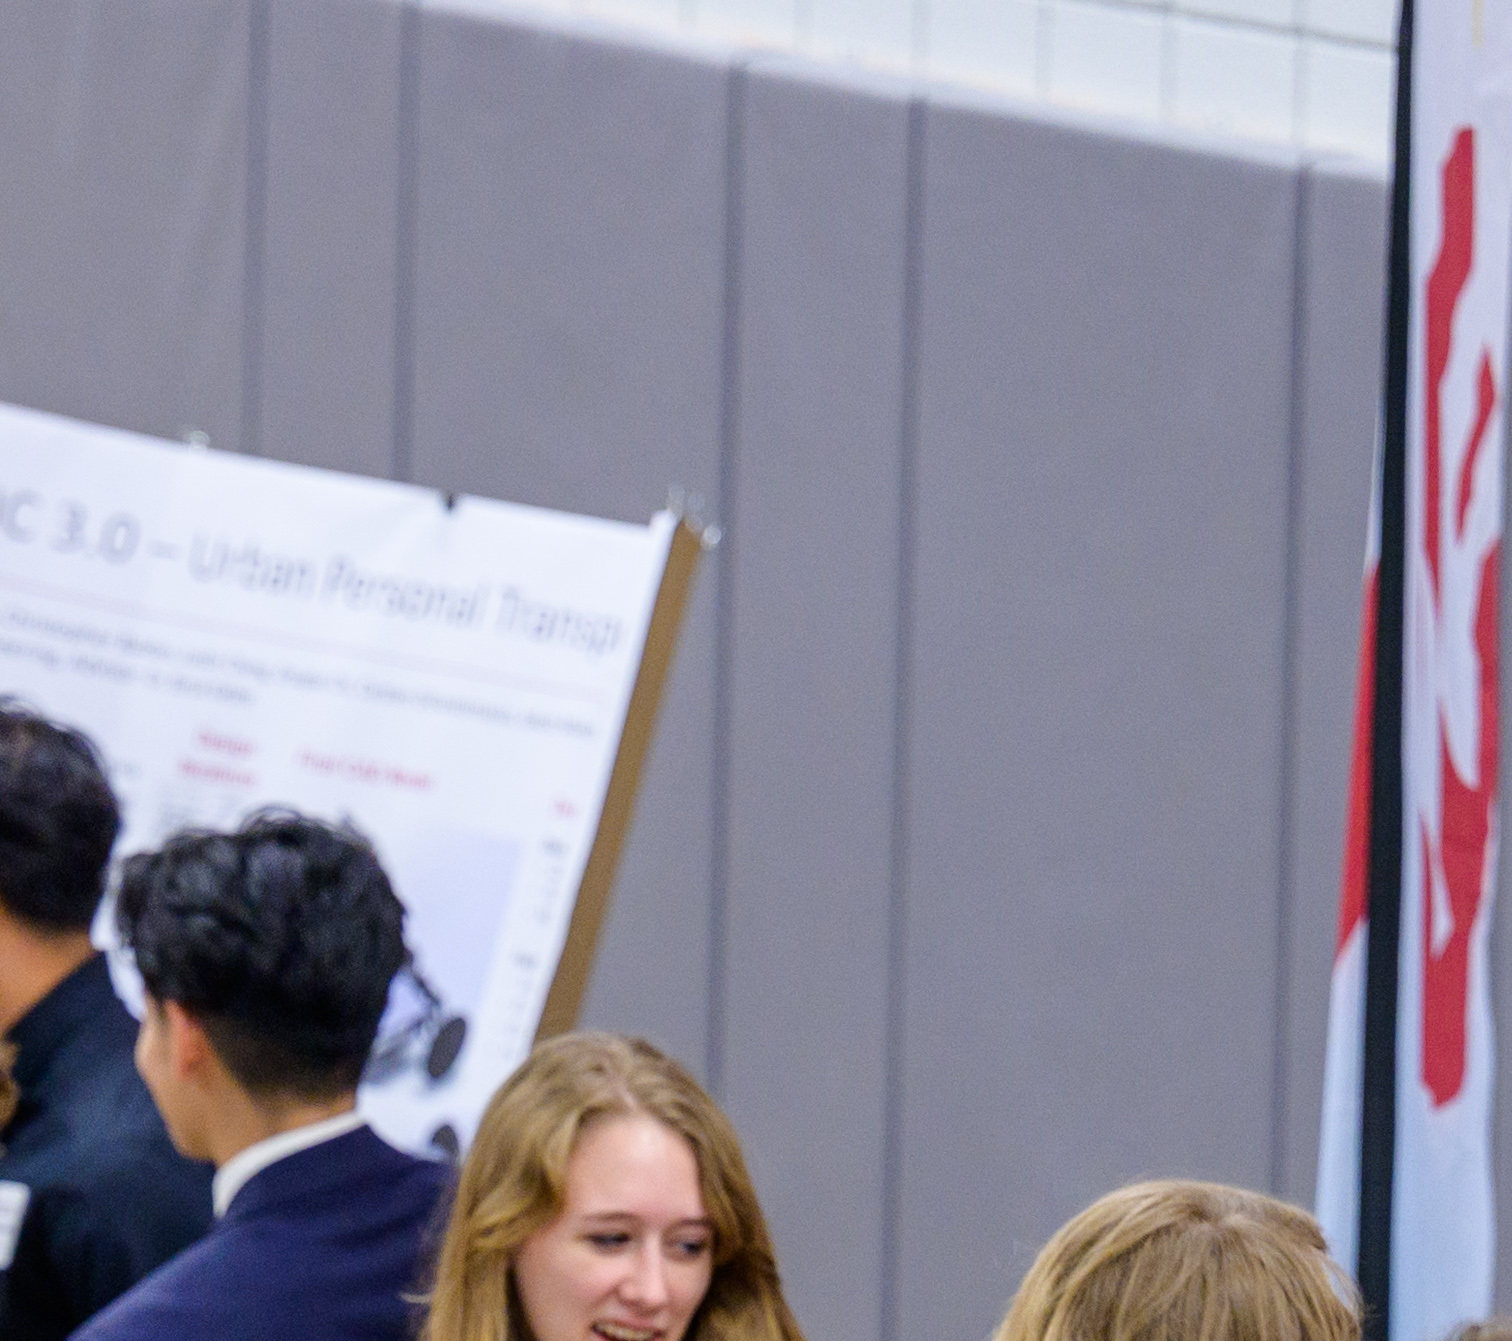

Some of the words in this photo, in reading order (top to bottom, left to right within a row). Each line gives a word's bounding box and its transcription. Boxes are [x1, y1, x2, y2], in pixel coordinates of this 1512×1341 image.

[52, 495, 142, 561] 3.0
[190, 535, 314, 591] Urban
[328, 555, 485, 627] Personal
